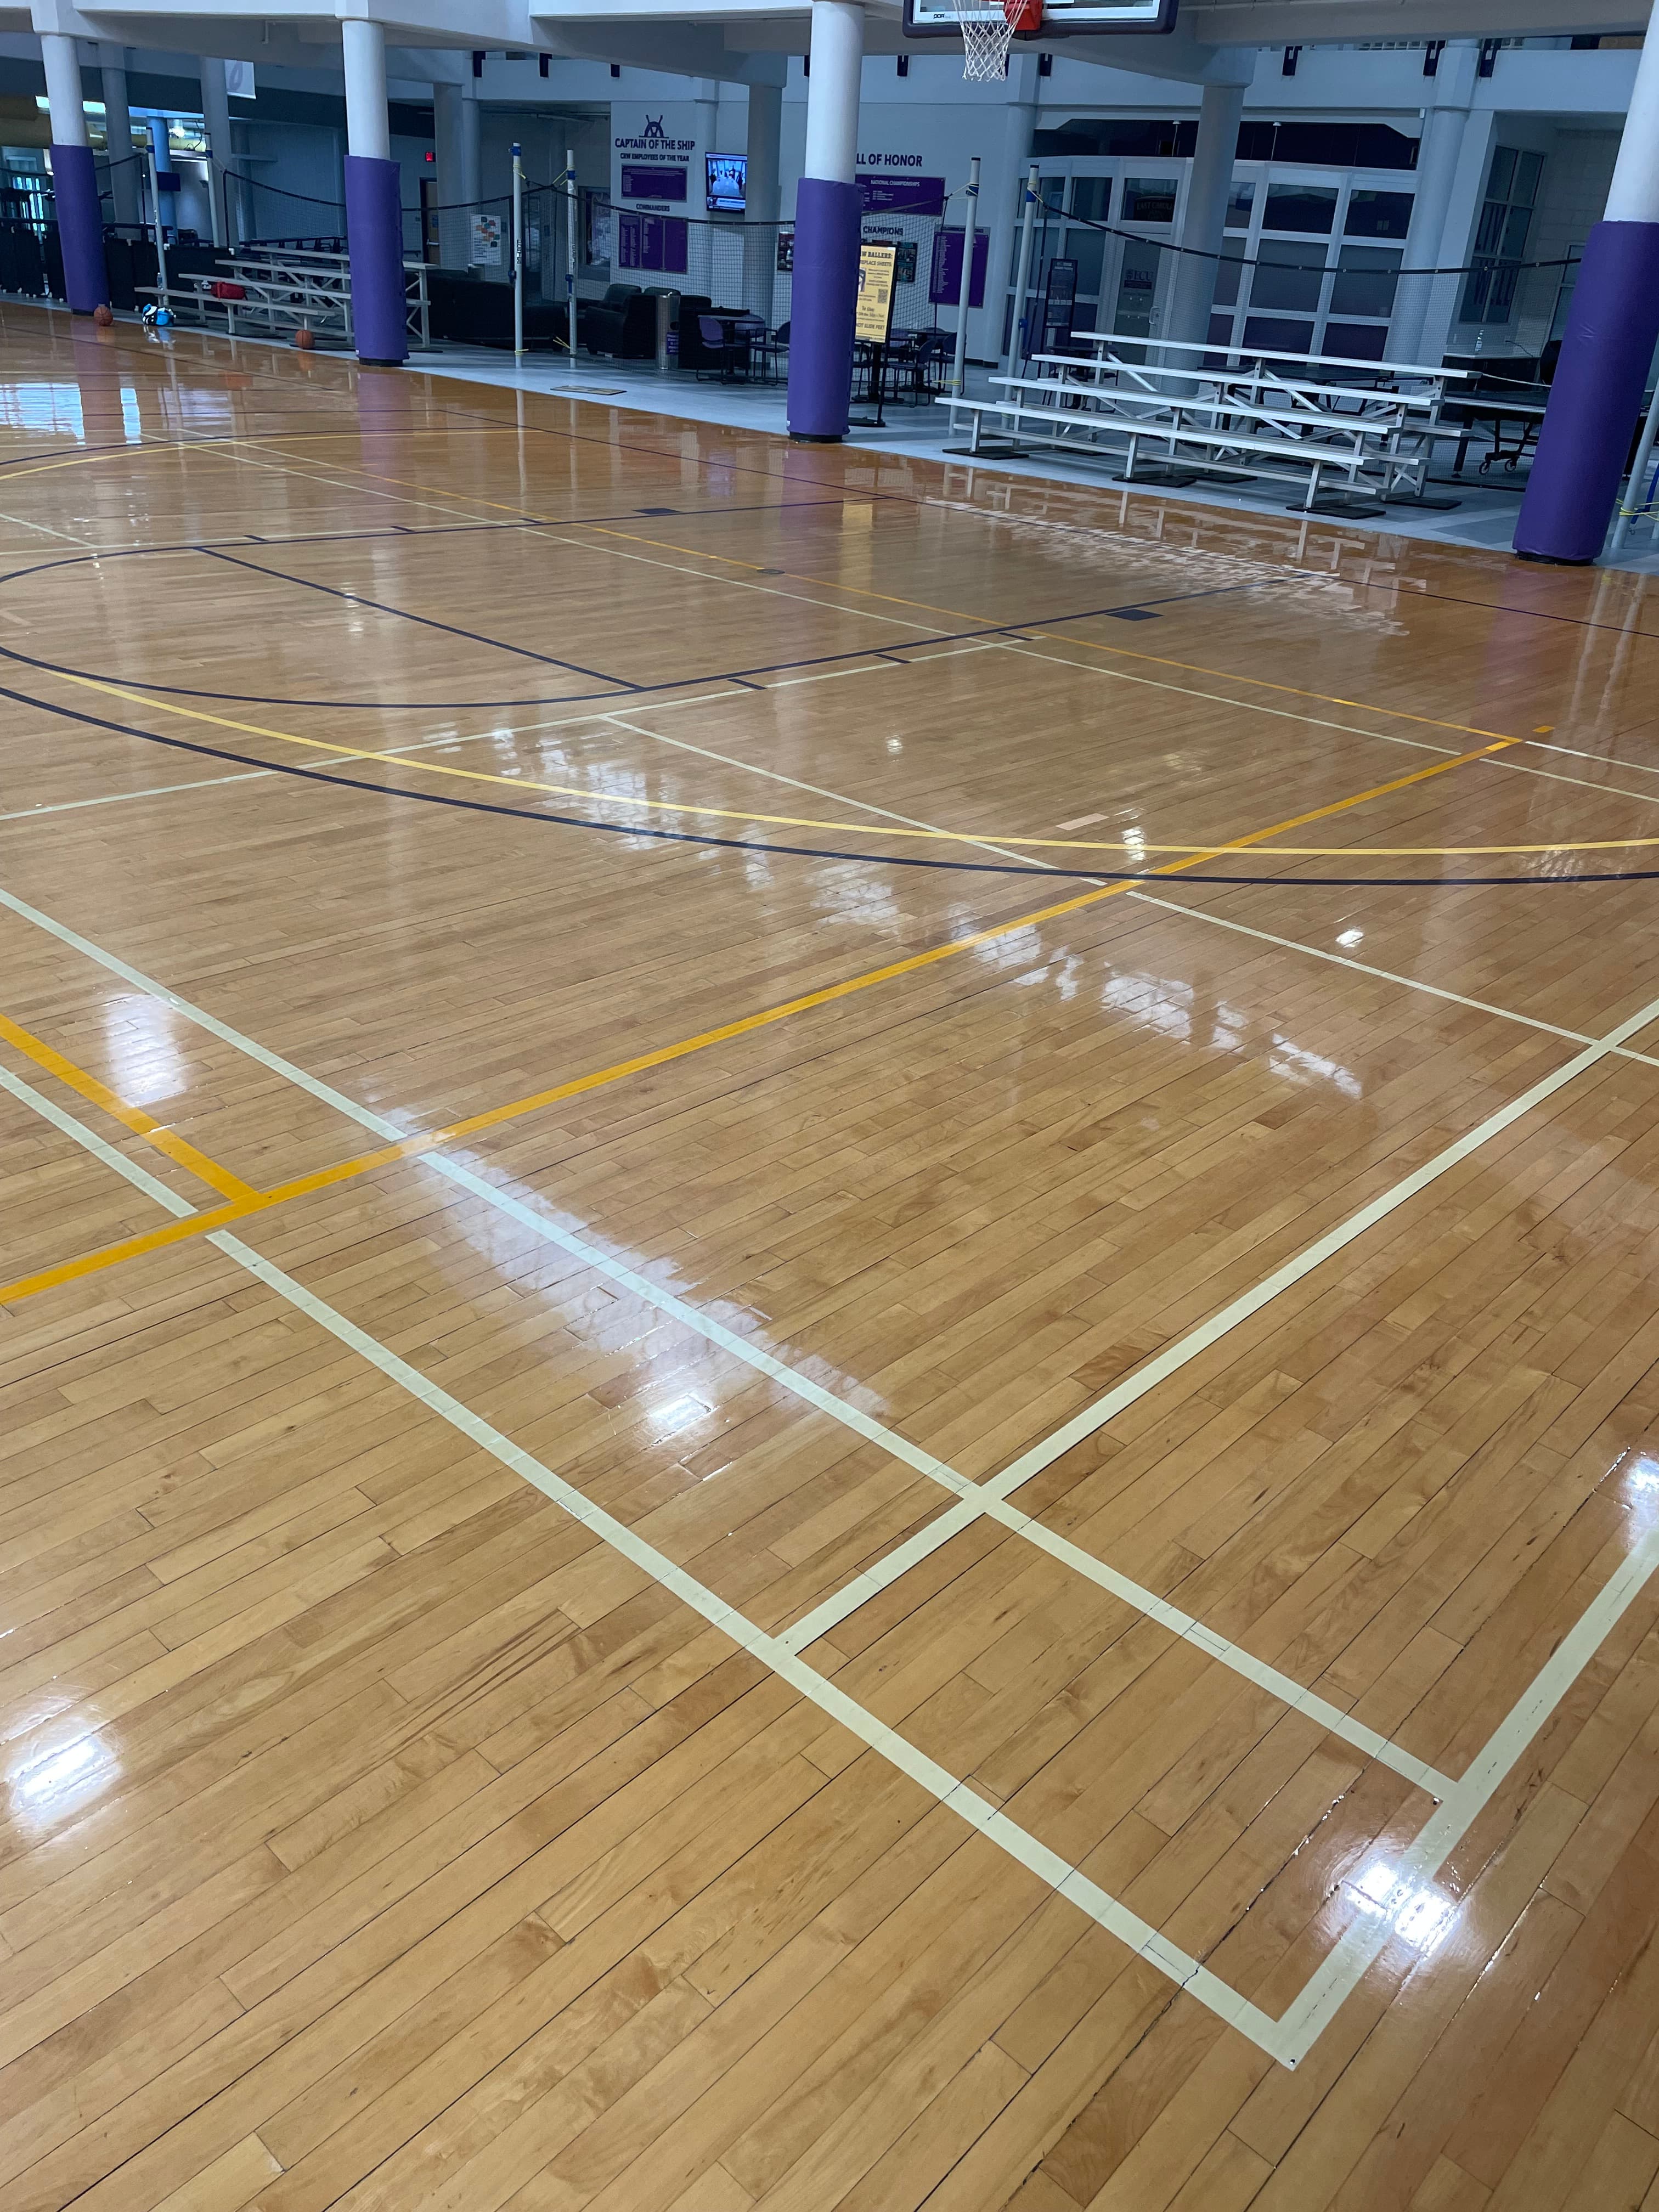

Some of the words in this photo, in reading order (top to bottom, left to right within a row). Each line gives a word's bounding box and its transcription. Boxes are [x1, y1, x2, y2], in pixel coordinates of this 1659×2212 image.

[615, 138, 646, 148] CAPTAIN
[648, 139, 659, 149] OF
[661, 139, 675, 150] THE
[677, 140, 695, 150] SHIP
[868, 153, 882, 165] OF
[884, 154, 923, 167] HONOR
[636, 204, 670, 212] COMMANDERS
[863, 225, 904, 236] CHAMPIONS
